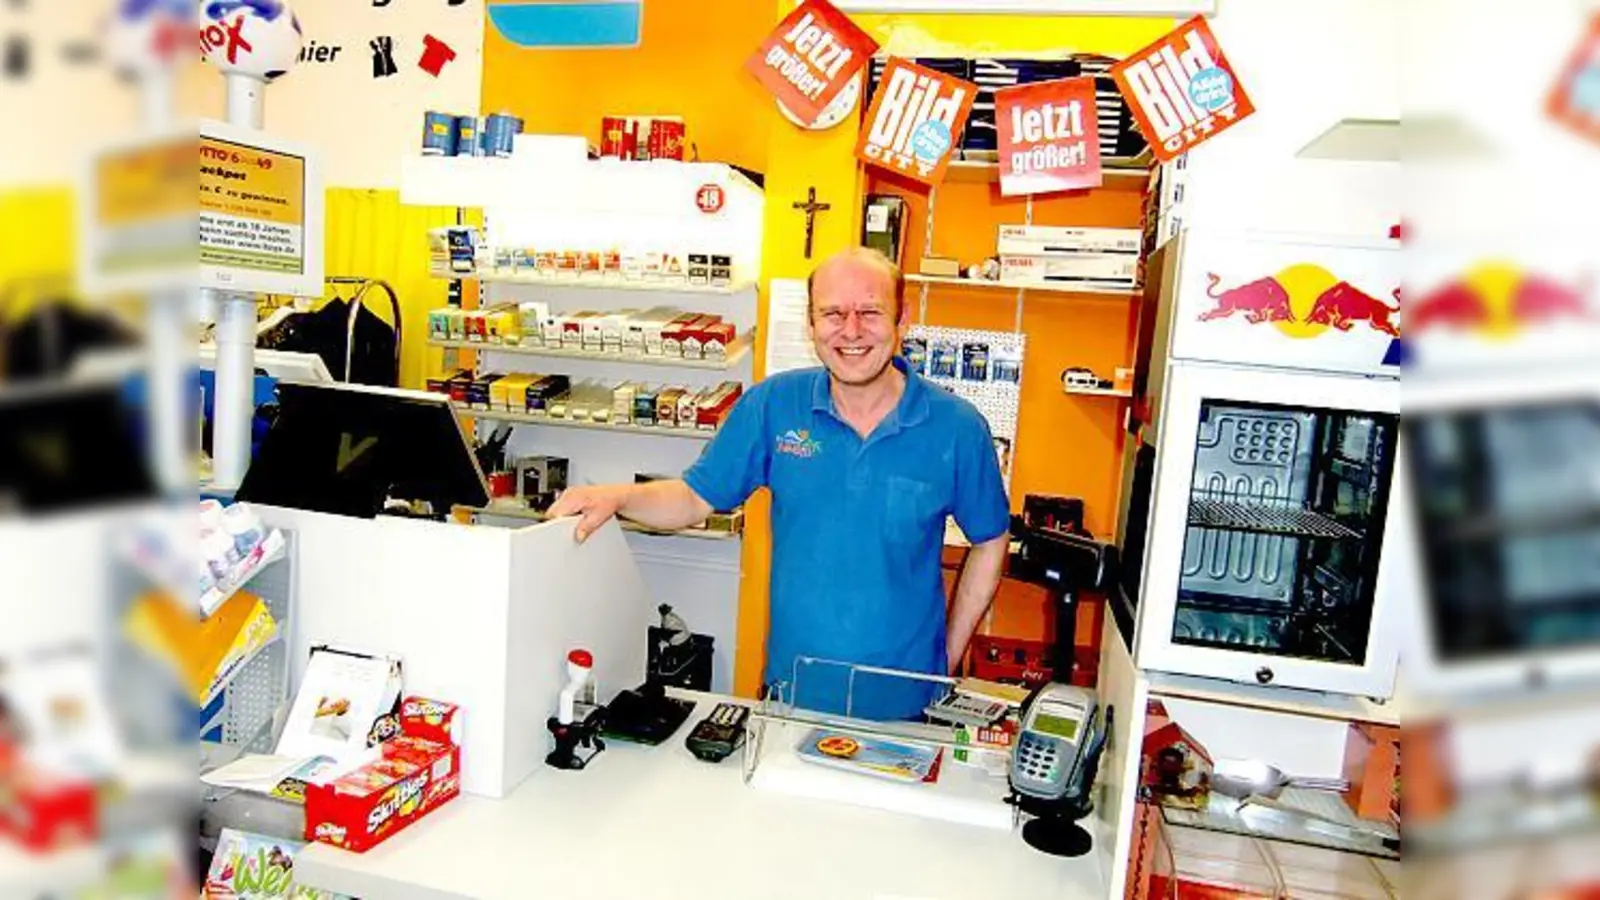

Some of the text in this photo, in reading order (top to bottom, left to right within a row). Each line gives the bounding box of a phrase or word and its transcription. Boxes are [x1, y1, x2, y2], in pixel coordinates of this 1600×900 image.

[784, 11, 853, 81] Jetzt
[867, 66, 966, 156] Bild
[1122, 28, 1235, 144] Bild
[1010, 99, 1085, 144] Jetzt
[1162, 101, 1238, 152] CITY
[864, 143, 936, 177] CITY
[1010, 140, 1087, 177] größer!
